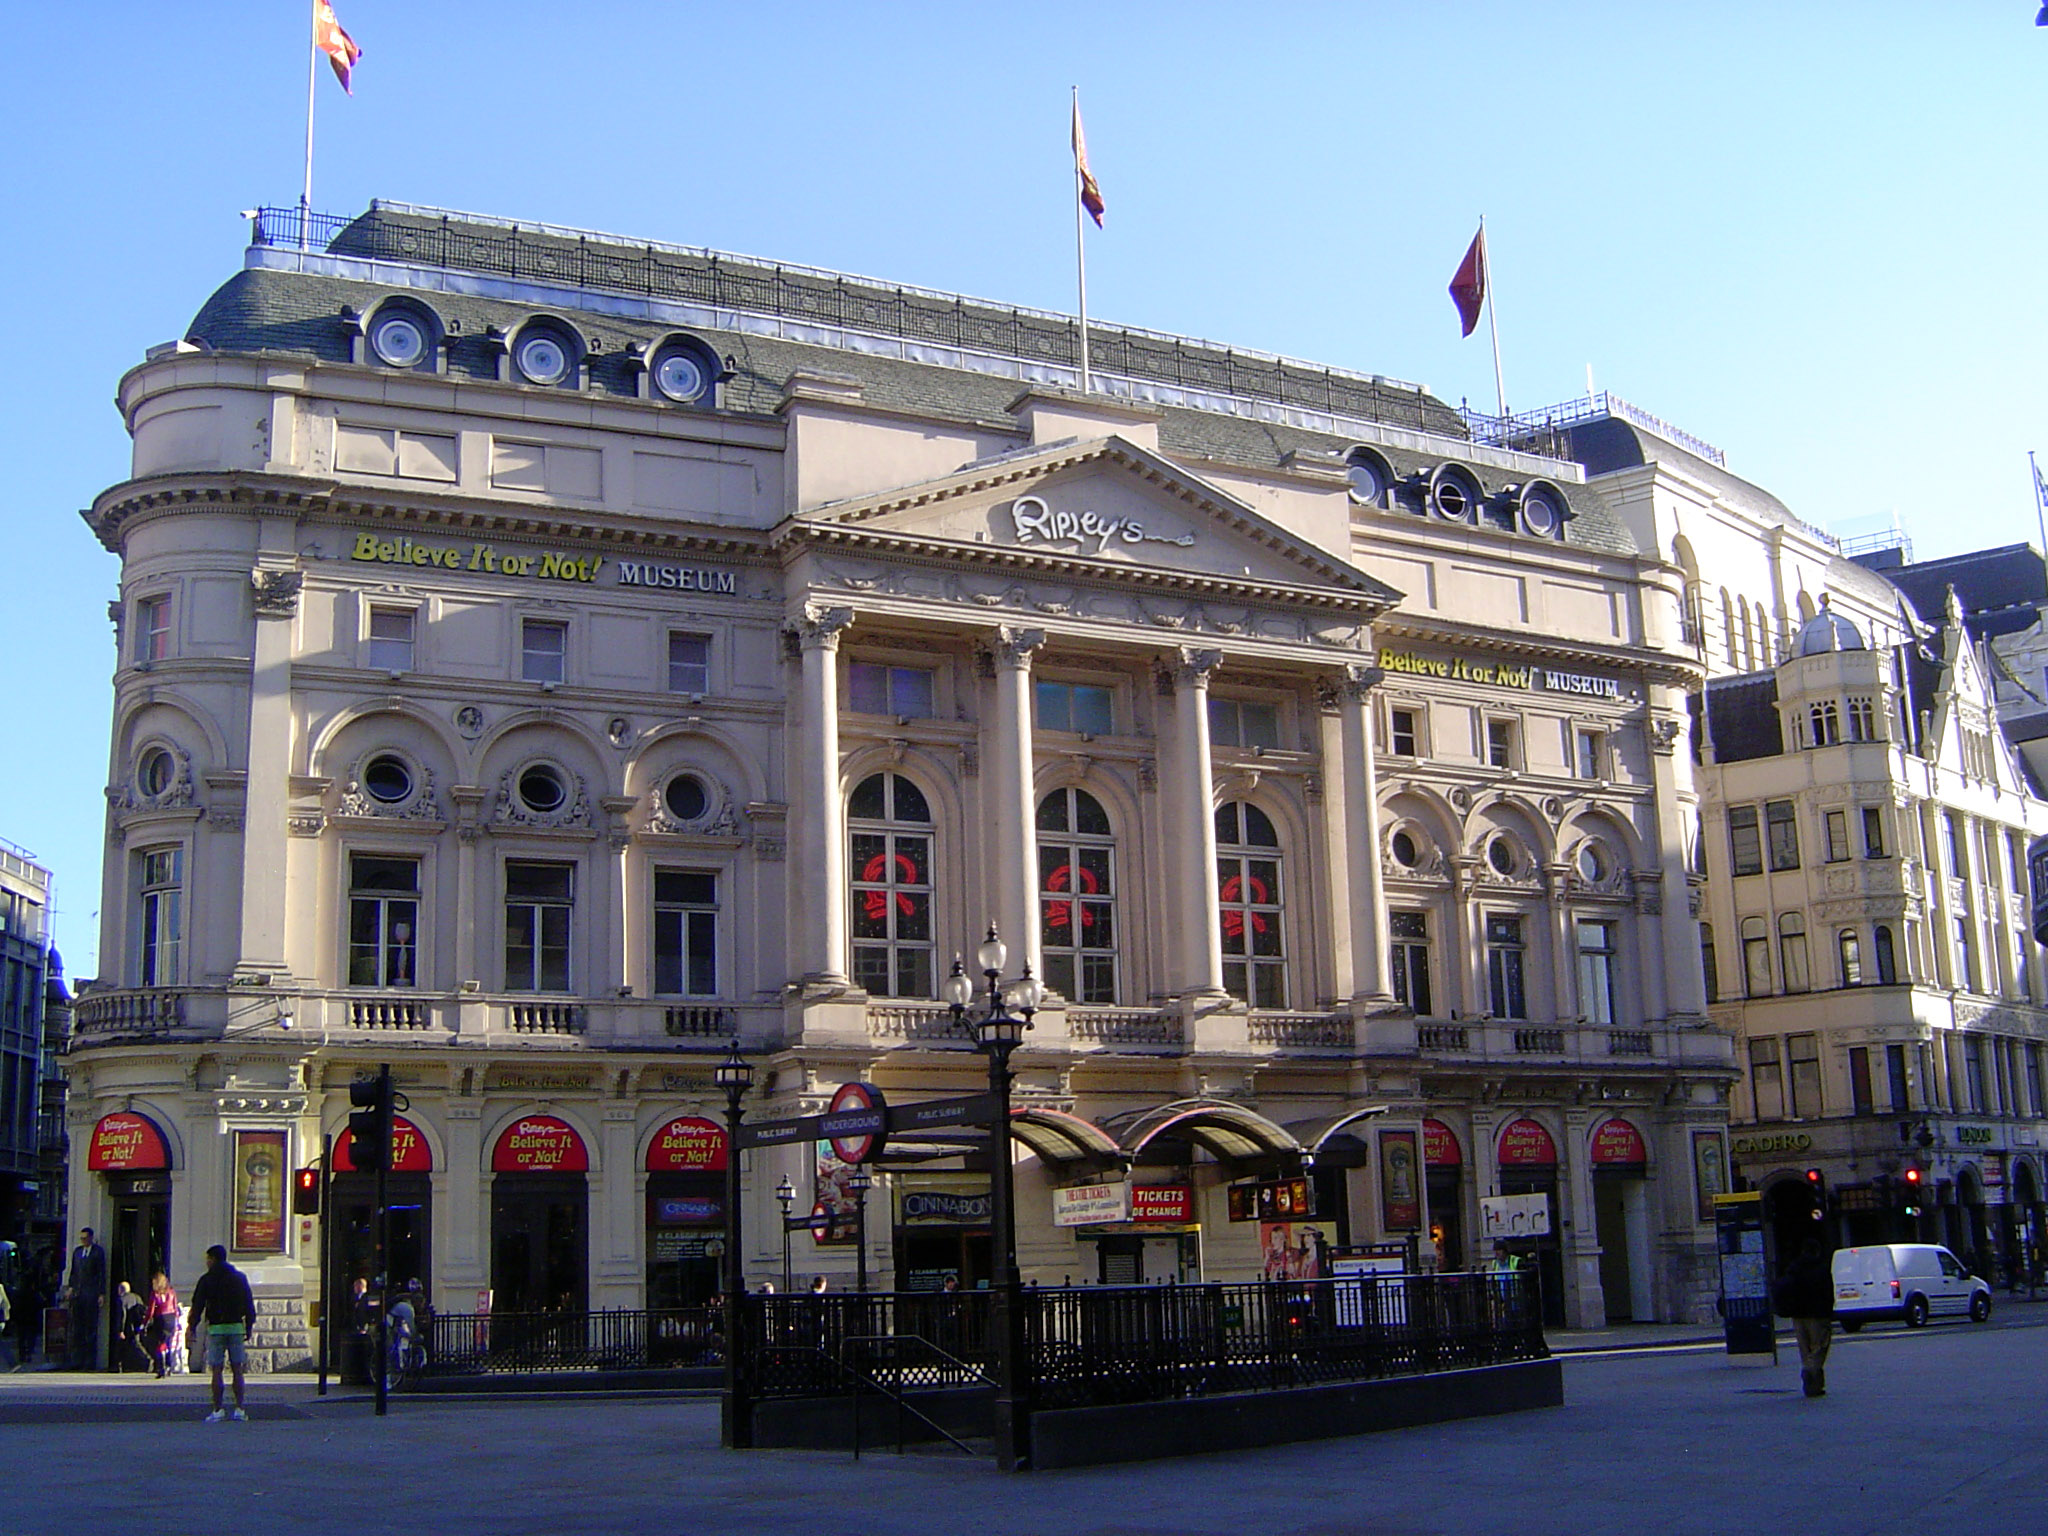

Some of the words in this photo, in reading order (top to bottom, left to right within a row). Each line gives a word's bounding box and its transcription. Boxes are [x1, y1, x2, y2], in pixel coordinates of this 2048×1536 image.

[351, 532, 462, 569] Believe
[468, 543, 496, 571] It
[502, 555, 532, 576] or
[539, 550, 604, 582] Not!
[617, 560, 736, 595] MUSEUM
[1379, 648, 1447, 677] Believe
[1451, 657, 1471, 680] It
[1473, 667, 1493, 683] or
[1496, 664, 1536, 690] Not!
[1545, 671, 1618, 696] MUSEUM
[917, 1109, 938, 1120] PUBLIC
[940, 1106, 966, 1118] SUBWAY
[822, 1115, 880, 1132] UNDERGROUND
[98, 1132, 129, 1146] Believe
[131, 1130, 143, 1144] It
[756, 1129, 775, 1138] PUBLIC
[775, 1127, 798, 1137] SUBWAY
[1599, 1134, 1626, 1145] Believe
[1957, 1126, 1992, 1143] LONDON
[401, 1133, 416, 1148] It
[509, 1135, 557, 1149] Believe
[560, 1135, 573, 1148] It
[661, 1135, 707, 1149] Believe
[710, 1136, 722, 1149] It
[1506, 1135, 1536, 1145] Believe
[101, 1150, 112, 1160] or
[111, 1144, 135, 1160] Not!
[517, 1152, 533, 1163] or
[534, 1149, 563, 1164] Not!
[669, 1153, 684, 1163] or
[686, 1149, 713, 1163] Not!
[1137, 1190, 1184, 1202] TICKETS
[906, 1195, 992, 1215] CINNABON
[1132, 1206, 1144, 1216] DE
[1146, 1206, 1182, 1216] CHANGE
